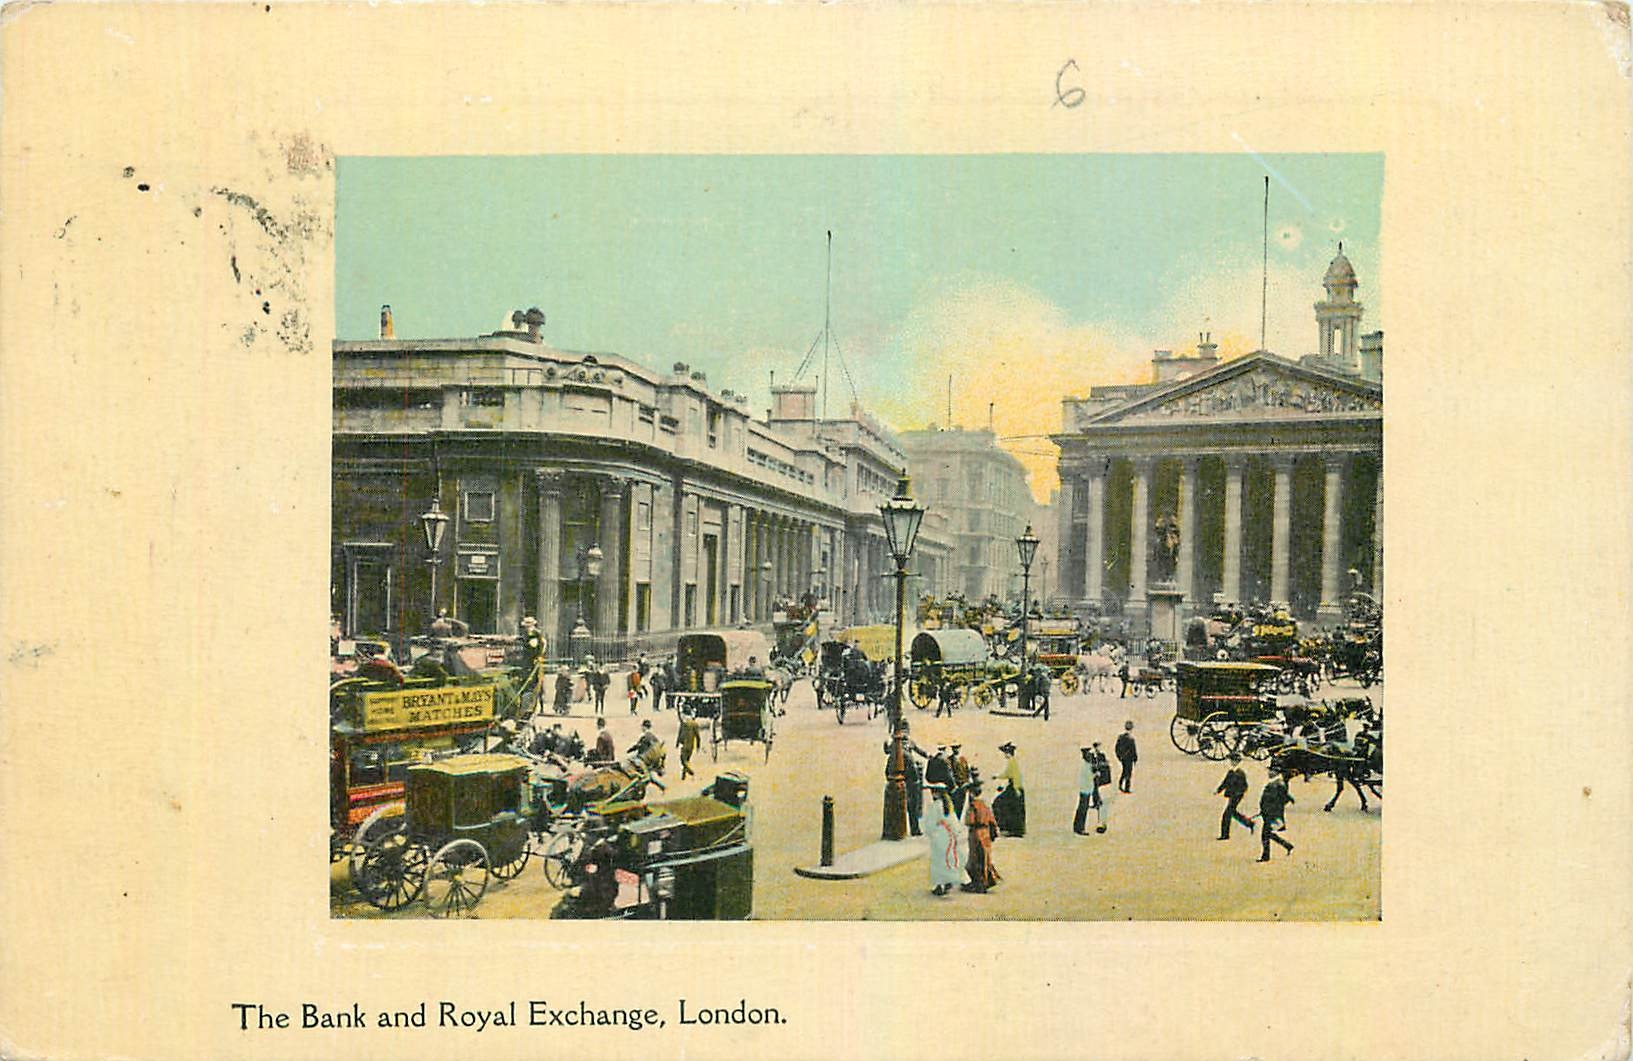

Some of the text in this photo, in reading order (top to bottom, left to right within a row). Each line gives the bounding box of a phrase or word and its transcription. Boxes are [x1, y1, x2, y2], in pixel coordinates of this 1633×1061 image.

[1053, 59, 1086, 108] 6
[402, 692, 454, 709] BRYANT
[409, 706, 483, 722] MATCHES
